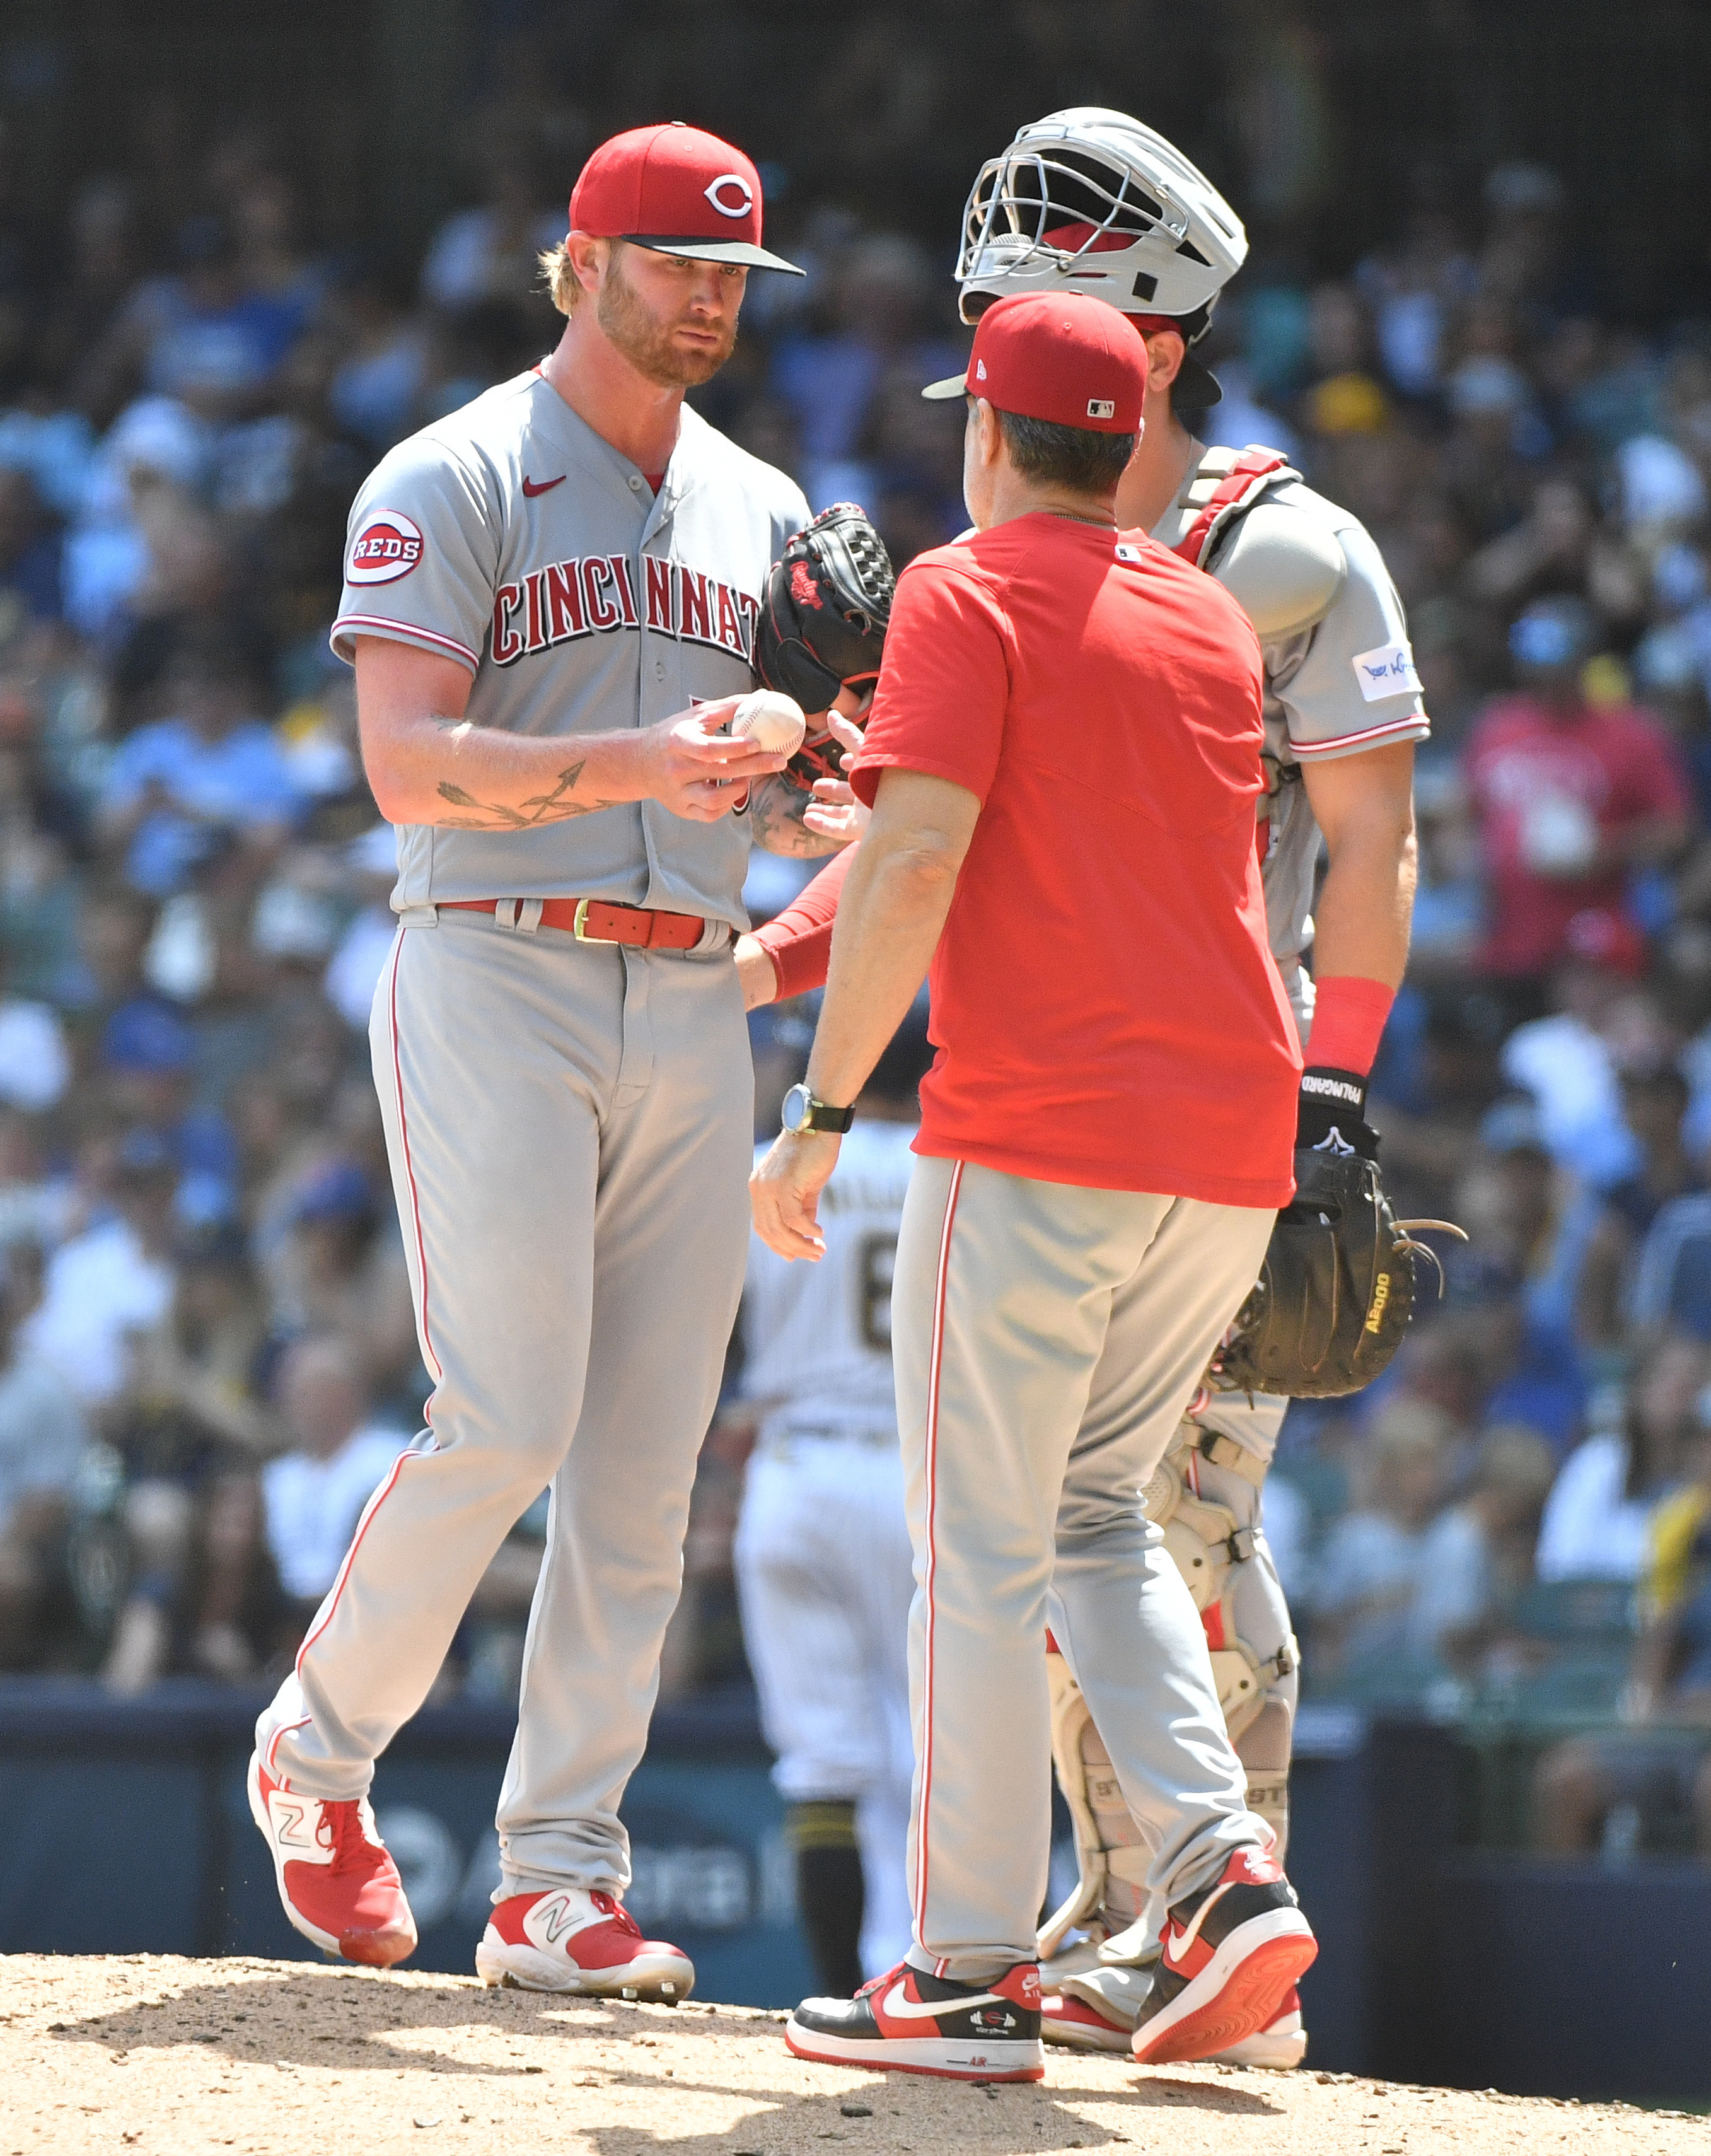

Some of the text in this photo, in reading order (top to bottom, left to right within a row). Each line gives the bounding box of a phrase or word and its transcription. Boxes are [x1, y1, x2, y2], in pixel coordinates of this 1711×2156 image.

[704, 173, 752, 219] C
[354, 538, 420, 560] REDS
[1302, 1075, 1363, 1105] PALMGARD
[1366, 1273, 1391, 1334] A2000
